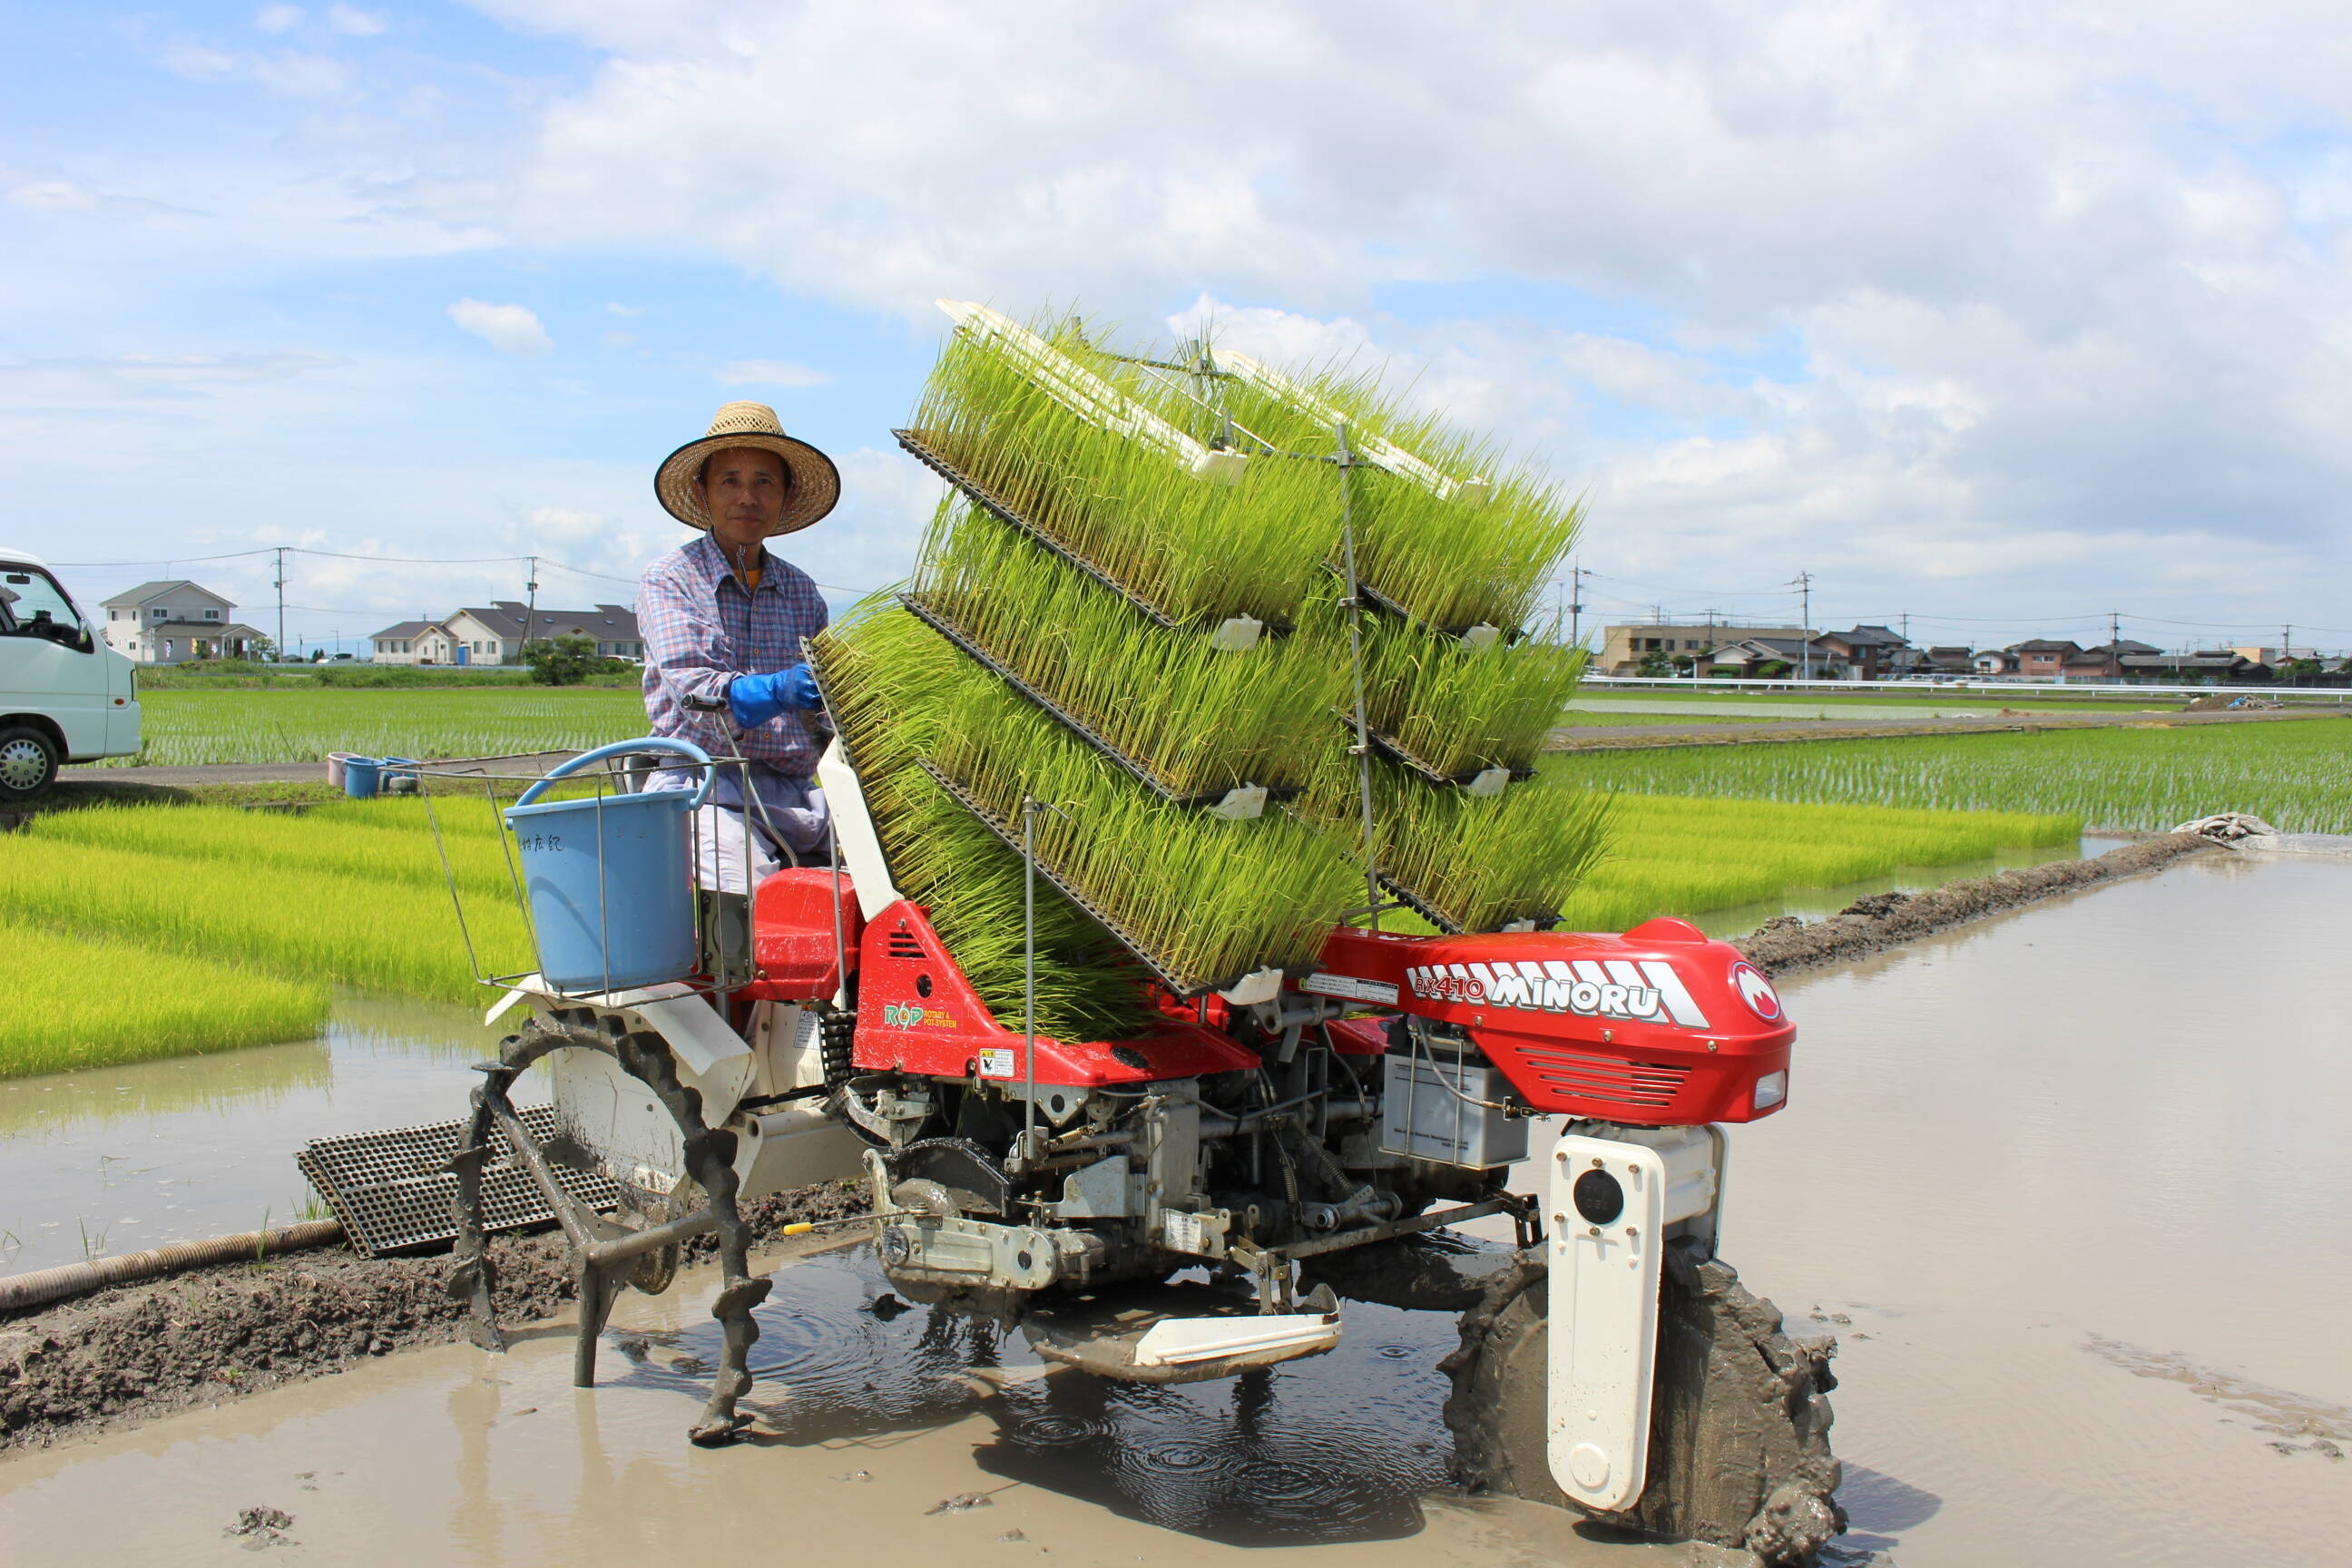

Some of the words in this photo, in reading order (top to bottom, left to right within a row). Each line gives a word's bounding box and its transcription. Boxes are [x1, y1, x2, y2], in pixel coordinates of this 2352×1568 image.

[1415, 975, 1485, 999] RX410
[1491, 975, 1661, 1017] MINORU
[924, 1010, 945, 1019] ROTARY
[924, 1018, 957, 1028] POT-SYSTEM
